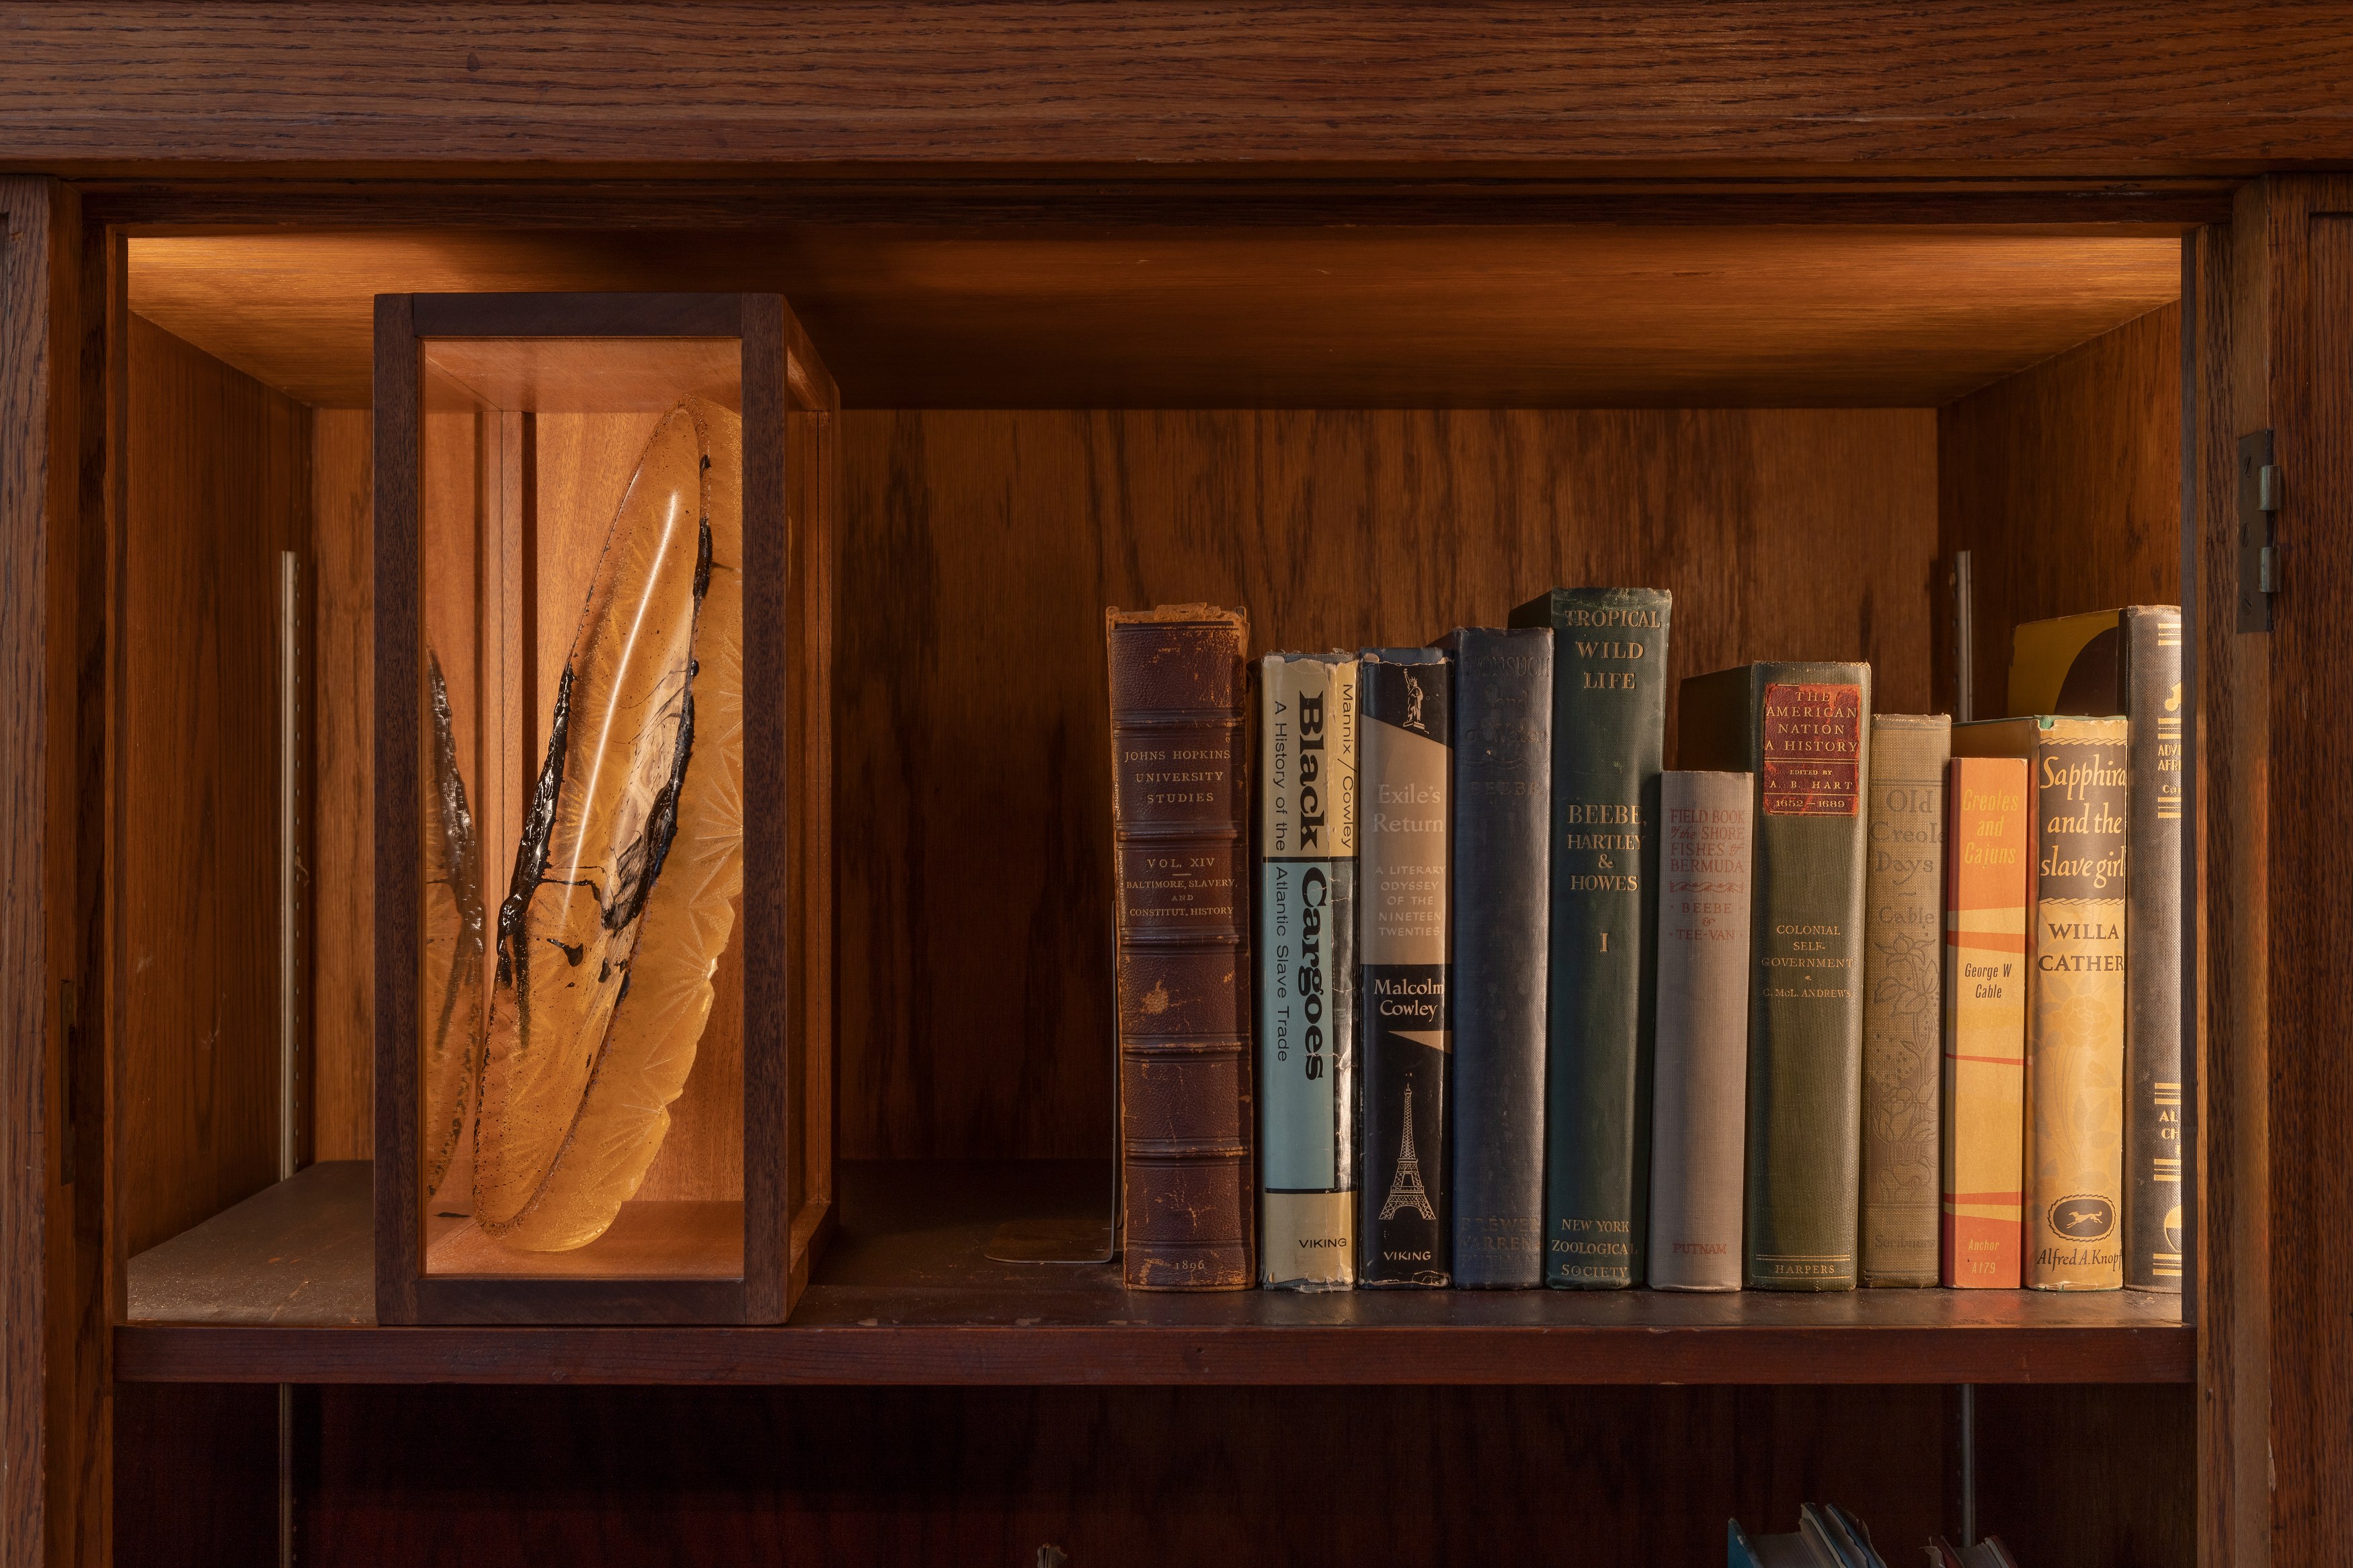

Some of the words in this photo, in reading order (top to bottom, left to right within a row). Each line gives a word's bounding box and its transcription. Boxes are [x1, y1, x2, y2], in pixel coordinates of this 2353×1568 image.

[1564, 610, 1661, 628] TROPICAL
[1575, 642, 1644, 659] WILD
[1583, 672, 1636, 689] LIFE
[1795, 692, 1830, 702] THE
[1275, 701, 1287, 714] A
[1766, 706, 1857, 718] AMERICAN
[1343, 684, 1353, 754] Mannix
[1778, 724, 1845, 735] NATION
[1765, 741, 1774, 750] A
[1785, 741, 1858, 752] HISTORY
[1125, 751, 1165, 762] JOHNS
[1172, 750, 1231, 759] HOPKINS
[1273, 723, 1287, 788] History
[1135, 772, 1224, 783] UNIVERSITY
[1299, 690, 1324, 851] Black
[2040, 753, 2126, 800] Sapphira
[1769, 780, 1782, 788] A.
[1812, 781, 1853, 790] HART
[1147, 793, 1214, 803] STUDIES
[1276, 796, 1287, 814] of
[1886, 789, 1933, 813] Old
[1963, 788, 2019, 811] Creoles
[1341, 776, 1354, 849] Cowley
[1568, 804, 1646, 826] BEEBE,
[1670, 809, 1708, 823] FIELD
[1712, 810, 1746, 824] BOOK
[2048, 802, 2089, 834] and
[2093, 802, 2122, 833] the
[1373, 813, 1444, 833] Return
[1977, 815, 2004, 837] and
[1276, 822, 1287, 851] the
[1670, 826, 1681, 839] of
[1679, 827, 1696, 839] the
[1702, 827, 1745, 840] SHORE
[1567, 834, 1646, 850] HARTLEY
[1671, 843, 1724, 856] FISHES
[1964, 841, 2016, 868] Cajuns
[1147, 859, 1182, 868] VOL.
[1191, 858, 1215, 868] XIV
[1599, 854, 1613, 868] &
[1670, 859, 1744, 873] BERMUDA
[2040, 845, 2091, 877] slave
[2093, 845, 2125, 889] girl
[1375, 866, 1384, 874] A
[1390, 866, 1447, 874] LITERARY
[1875, 851, 1933, 886] Days
[1126, 880, 1187, 889] BALTIMORE,
[1189, 879, 1238, 889] SLAVERY,
[1381, 881, 1439, 891] ODYSSEY
[1570, 875, 1638, 891] HOWES
[1276, 866, 1288, 936] Atlantic
[1387, 896, 1404, 905] OF
[1411, 896, 1433, 905] THE
[1130, 909, 1188, 917] CONSTITUT.
[1191, 907, 1233, 916] HISTORY
[1682, 903, 1732, 913] BEEBE
[1379, 912, 1441, 921] NINETEEN
[1878, 907, 1935, 924] Cable
[1378, 927, 1441, 936] TWENTIES
[1676, 930, 1736, 941] TEE-VAN
[1777, 925, 1840, 935] COLONIAL
[2048, 923, 2120, 940] WILLA
[1600, 932, 1608, 952] I
[1793, 942, 1826, 951] SELF-
[1761, 957, 1853, 968] GOVERNMENT
[2039, 954, 2124, 971] CATHER
[1277, 945, 1289, 998] Slave
[1298, 867, 1327, 1080] Cargoes
[1964, 963, 1998, 981] George
[2003, 963, 2012, 977] W
[1373, 979, 1445, 995] Malcolm
[1763, 989, 1773, 997] C.
[1802, 989, 1851, 998] ANDREWS
[1976, 984, 2002, 998] Cable
[1380, 999, 1438, 1022] Cowley
[1277, 1006, 1289, 1061] Trade
[1562, 1219, 1593, 1231] NEW
[1596, 1221, 1630, 1232] YORK
[1299, 1238, 1347, 1248] VIKING
[1552, 1240, 1638, 1255] ZOOLOGICAL
[1672, 1243, 1727, 1255] PUTNAM
[1968, 1239, 1999, 1251] Anchor
[1384, 1251, 1431, 1261] VIKING
[2036, 1247, 2077, 1272] Alfred
[2078, 1249, 2090, 1265] A.
[2092, 1249, 2122, 1272] Knopf
[1175, 1260, 1205, 1272] 1896
[1561, 1264, 1628, 1278] SOCIETY
[1775, 1265, 1835, 1274] HARPERS
[1972, 1262, 1996, 1274] A179
